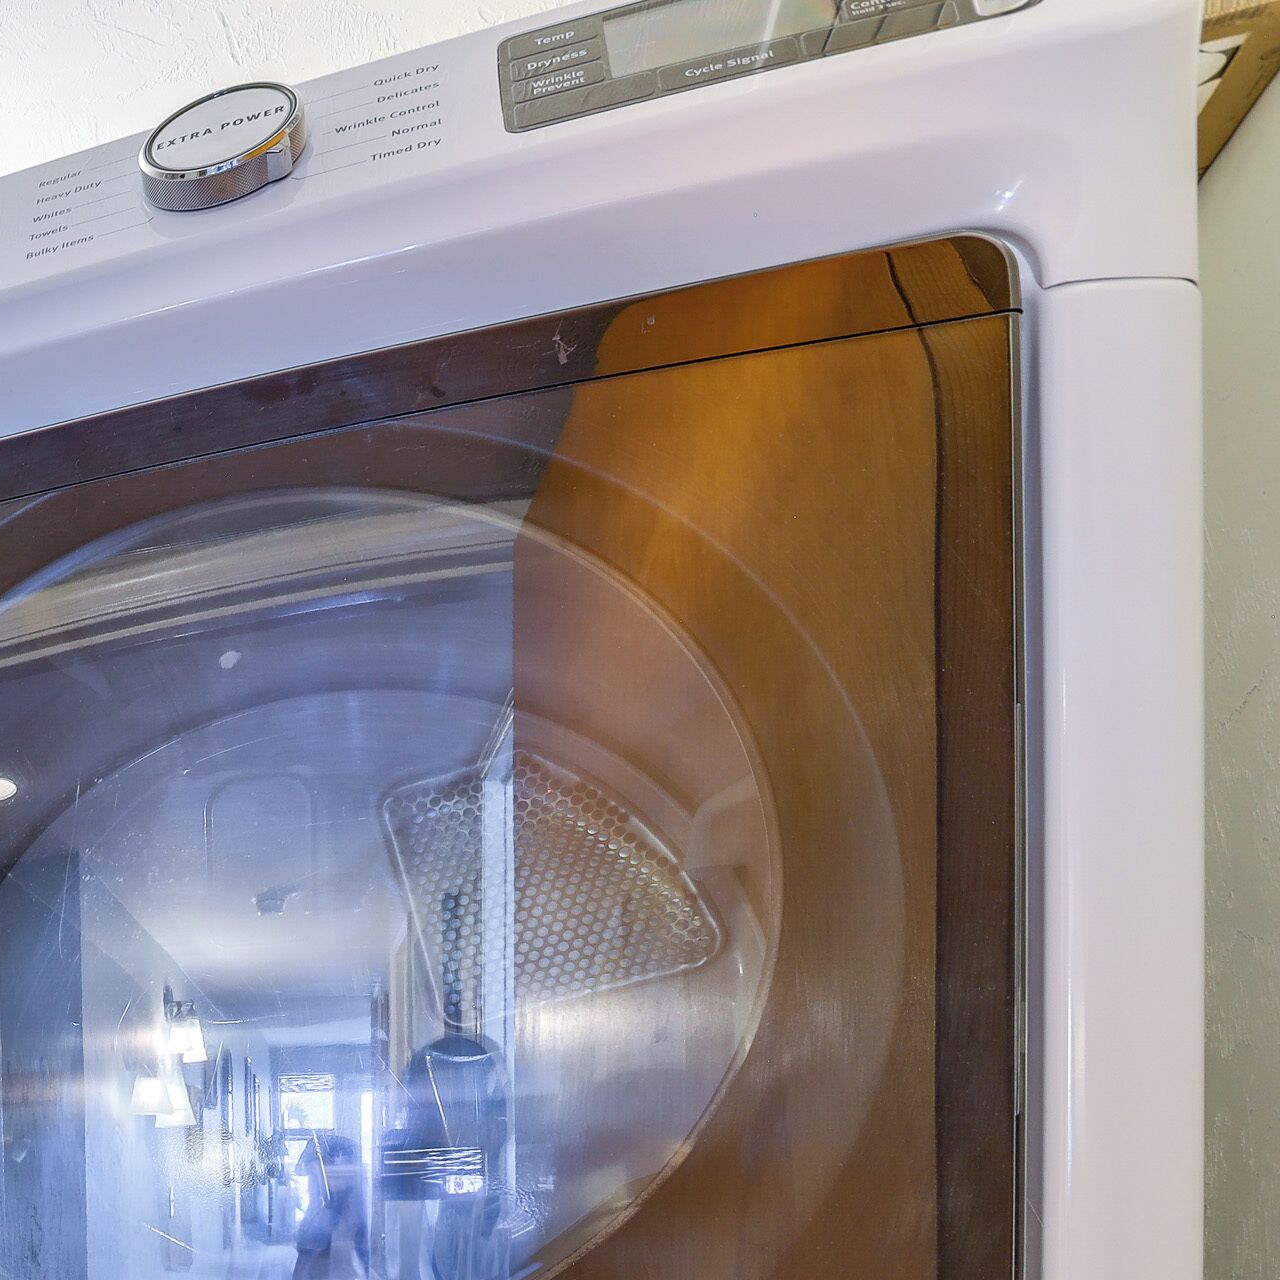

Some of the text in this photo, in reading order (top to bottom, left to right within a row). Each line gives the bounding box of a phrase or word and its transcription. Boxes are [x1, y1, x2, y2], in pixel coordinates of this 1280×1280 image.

[851, 5, 875, 16] Hold
[535, 30, 575, 46] Temp
[526, 49, 588, 71] Dryness
[684, 49, 774, 78] Cycle Signal
[373, 64, 440, 87] Quick Dry
[531, 69, 585, 89] Wrinkle
[377, 82, 440, 103] Delicates
[532, 77, 585, 96] Prevent
[335, 100, 440, 134] Wrinkle Control
[391, 118, 442, 137] Normal
[156, 105, 285, 151] EXTRA POWER
[370, 138, 442, 161] Timed Dry
[38, 170, 82, 188] Regular
[36, 181, 102, 205] Heavy Duty
[32, 207, 72, 223] Whites
[29, 225, 68, 241] Towels
[26, 235, 94, 260] Bulky Items
